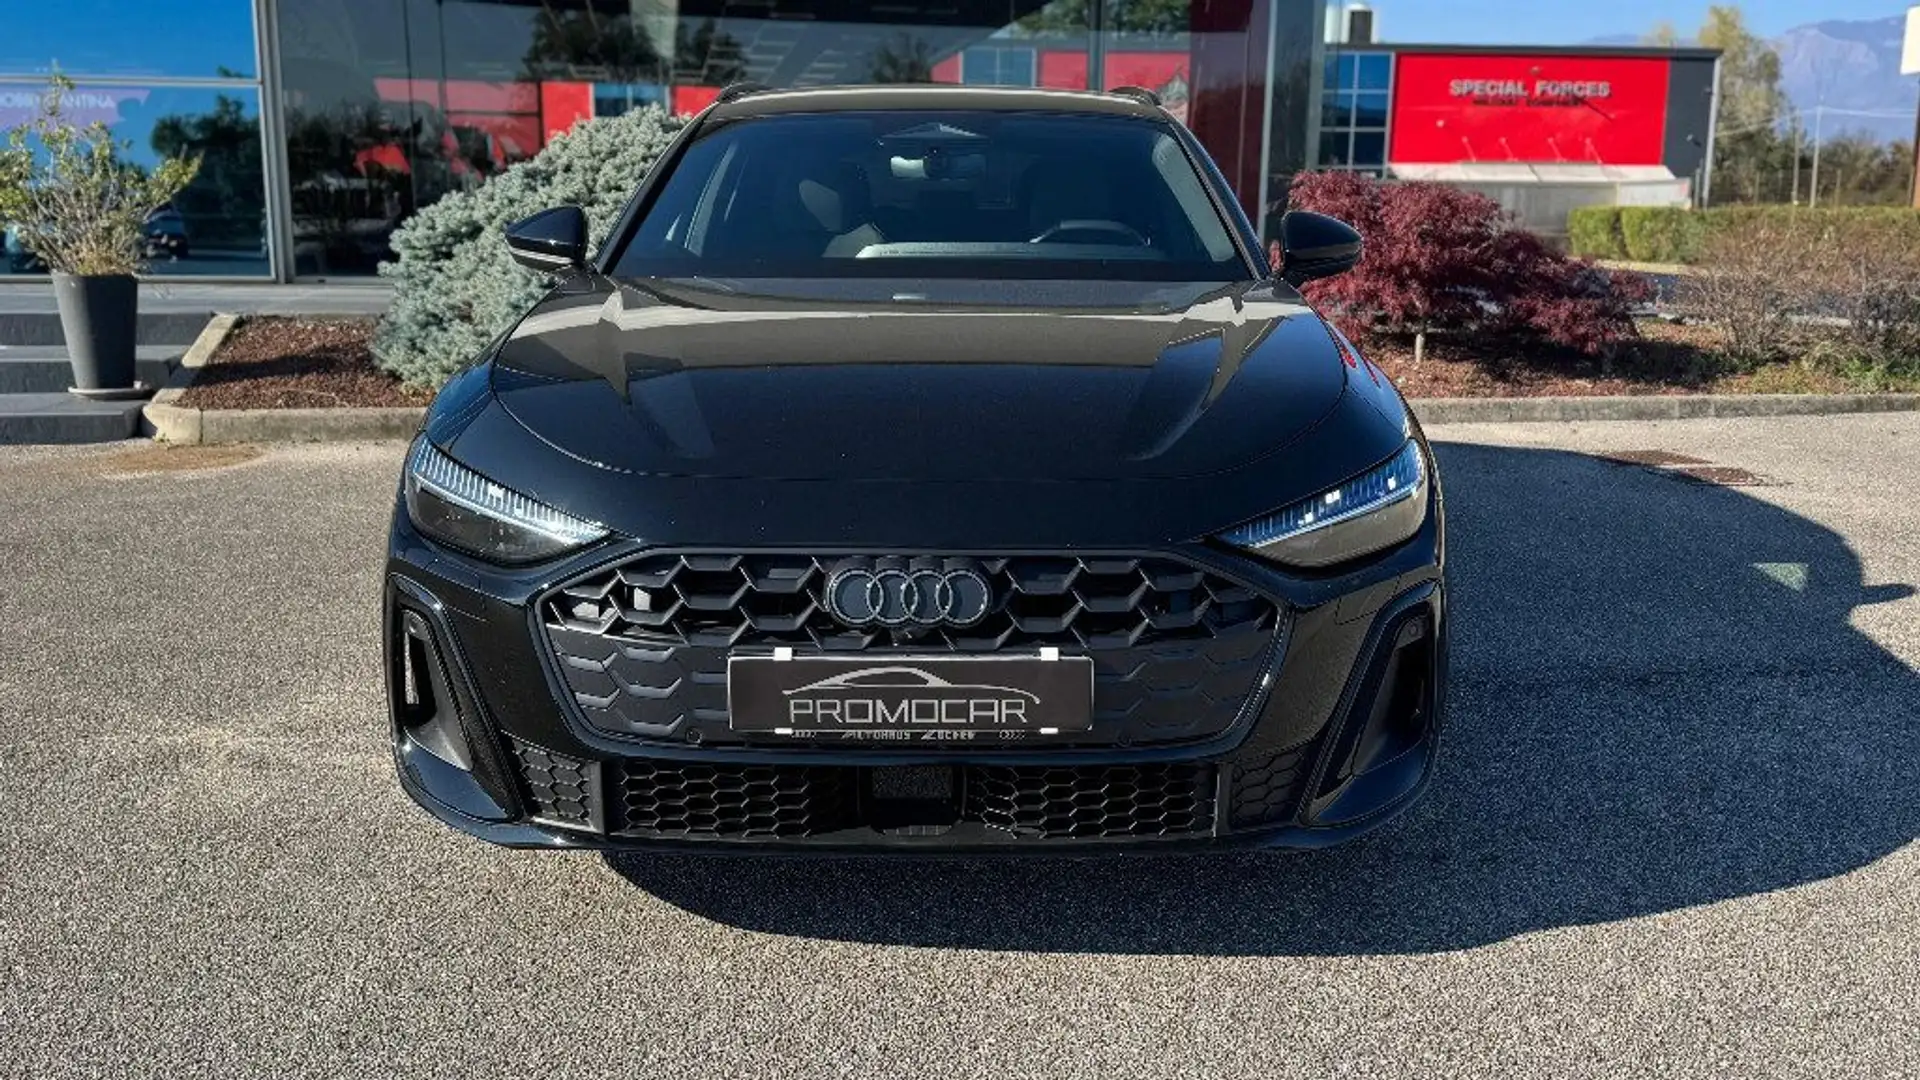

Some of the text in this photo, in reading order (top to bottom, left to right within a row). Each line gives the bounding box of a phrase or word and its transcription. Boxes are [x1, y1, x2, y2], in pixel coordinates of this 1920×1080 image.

[1450, 79, 1611, 98] SPECIAL FORCES
[789, 699, 1028, 723] PROMOCAR
